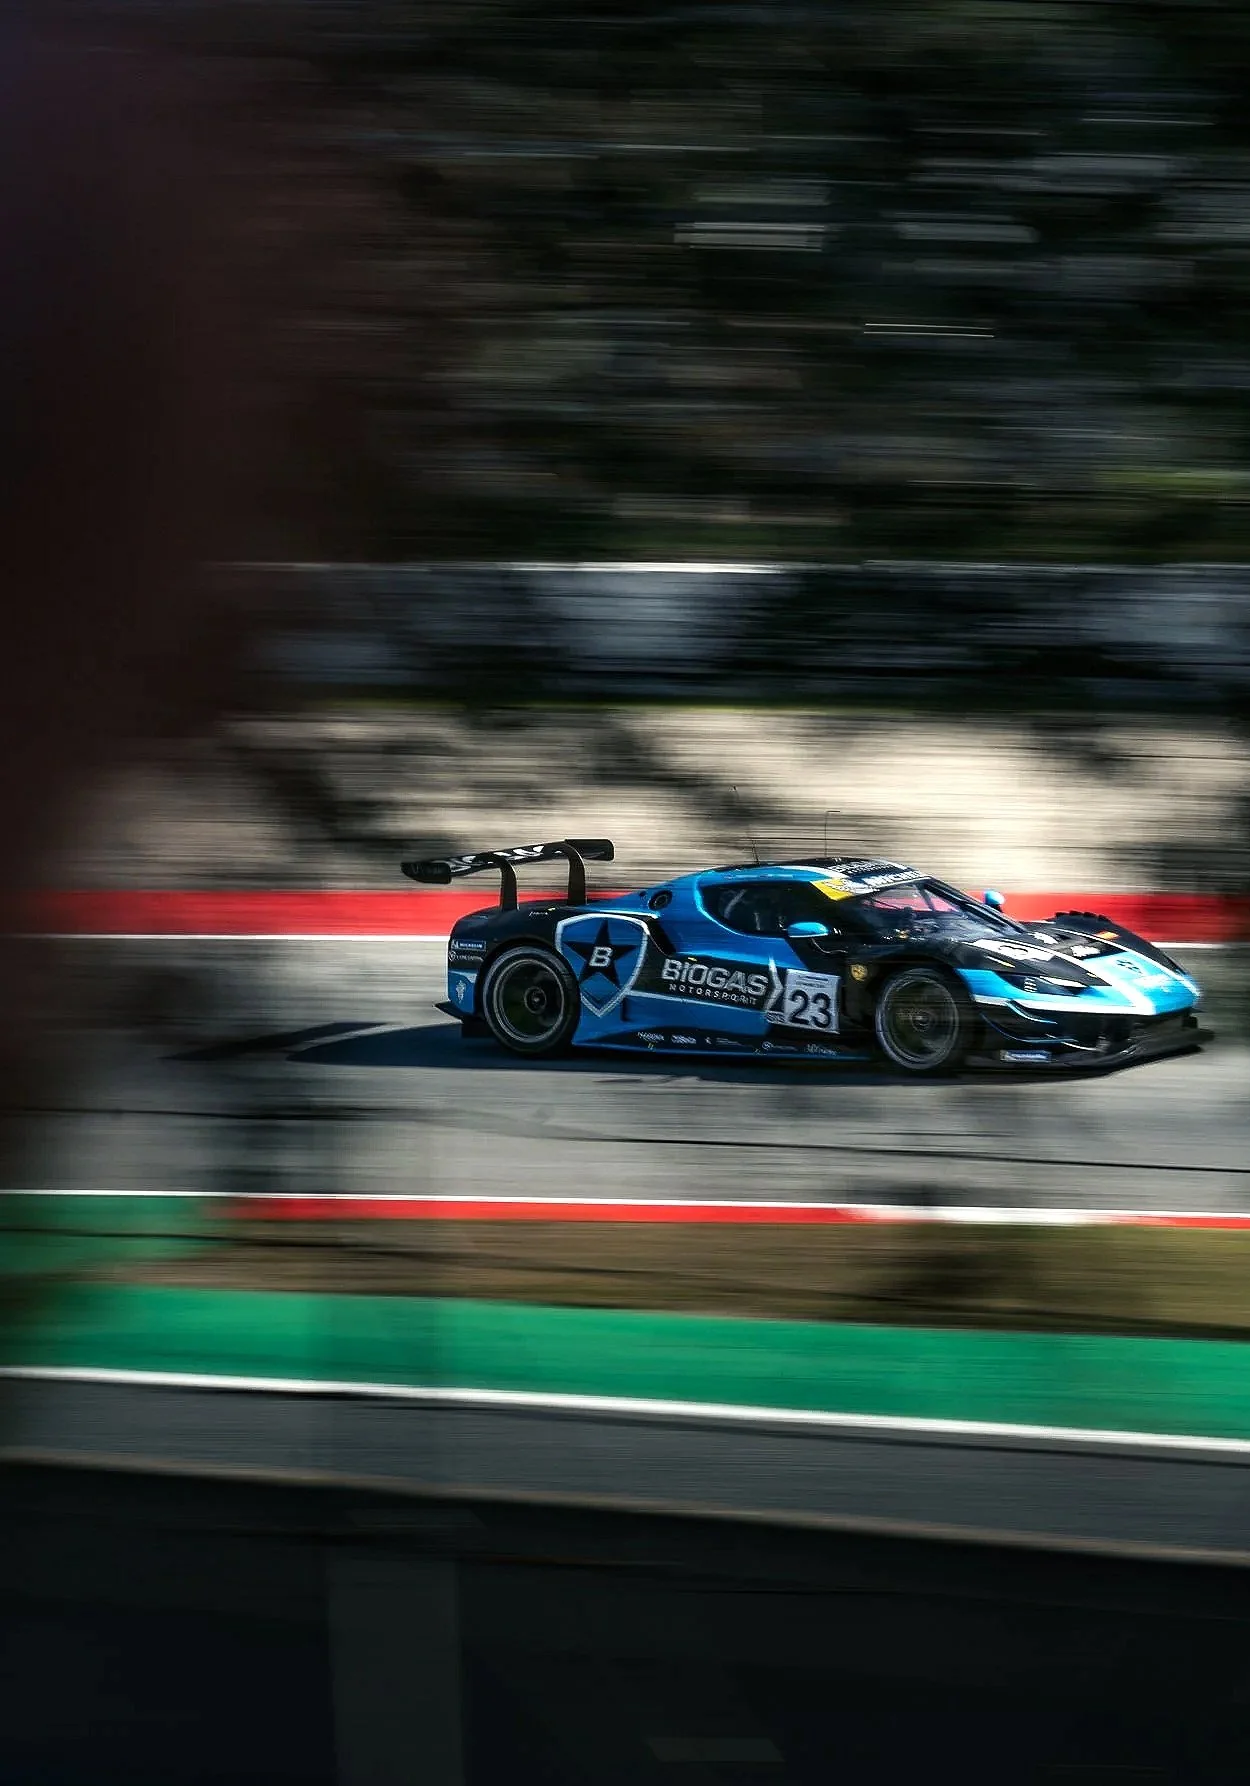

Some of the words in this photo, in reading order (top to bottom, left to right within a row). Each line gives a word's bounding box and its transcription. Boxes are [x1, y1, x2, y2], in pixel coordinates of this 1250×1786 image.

[589, 946, 613, 967] B
[661, 958, 769, 996] BIOGAS
[790, 989, 831, 1028] 23
